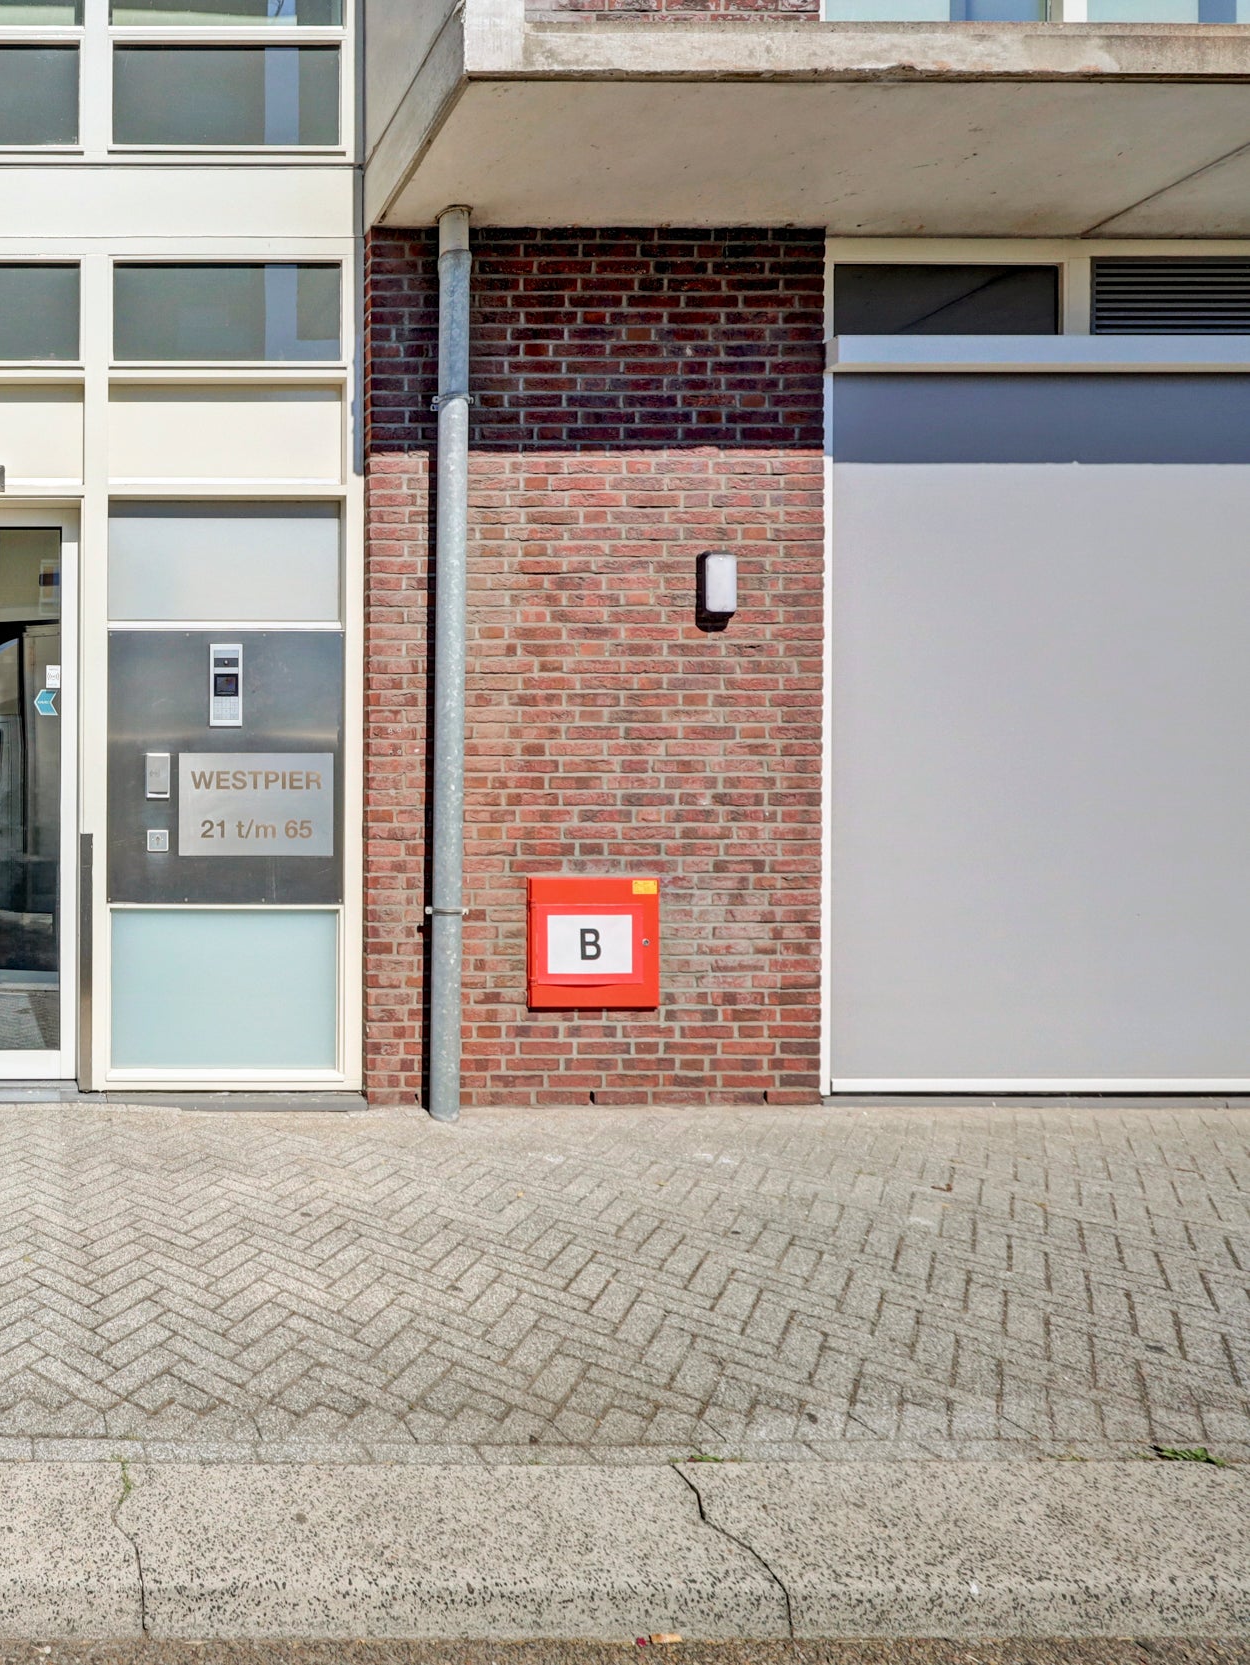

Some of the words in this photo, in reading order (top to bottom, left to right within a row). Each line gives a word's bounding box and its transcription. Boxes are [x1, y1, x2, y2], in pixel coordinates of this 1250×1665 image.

[190, 770, 323, 790] WESTPIER
[200, 819, 226, 839] 21
[235, 818, 277, 839] t/m
[284, 819, 314, 839] 65
[579, 928, 602, 961] B
